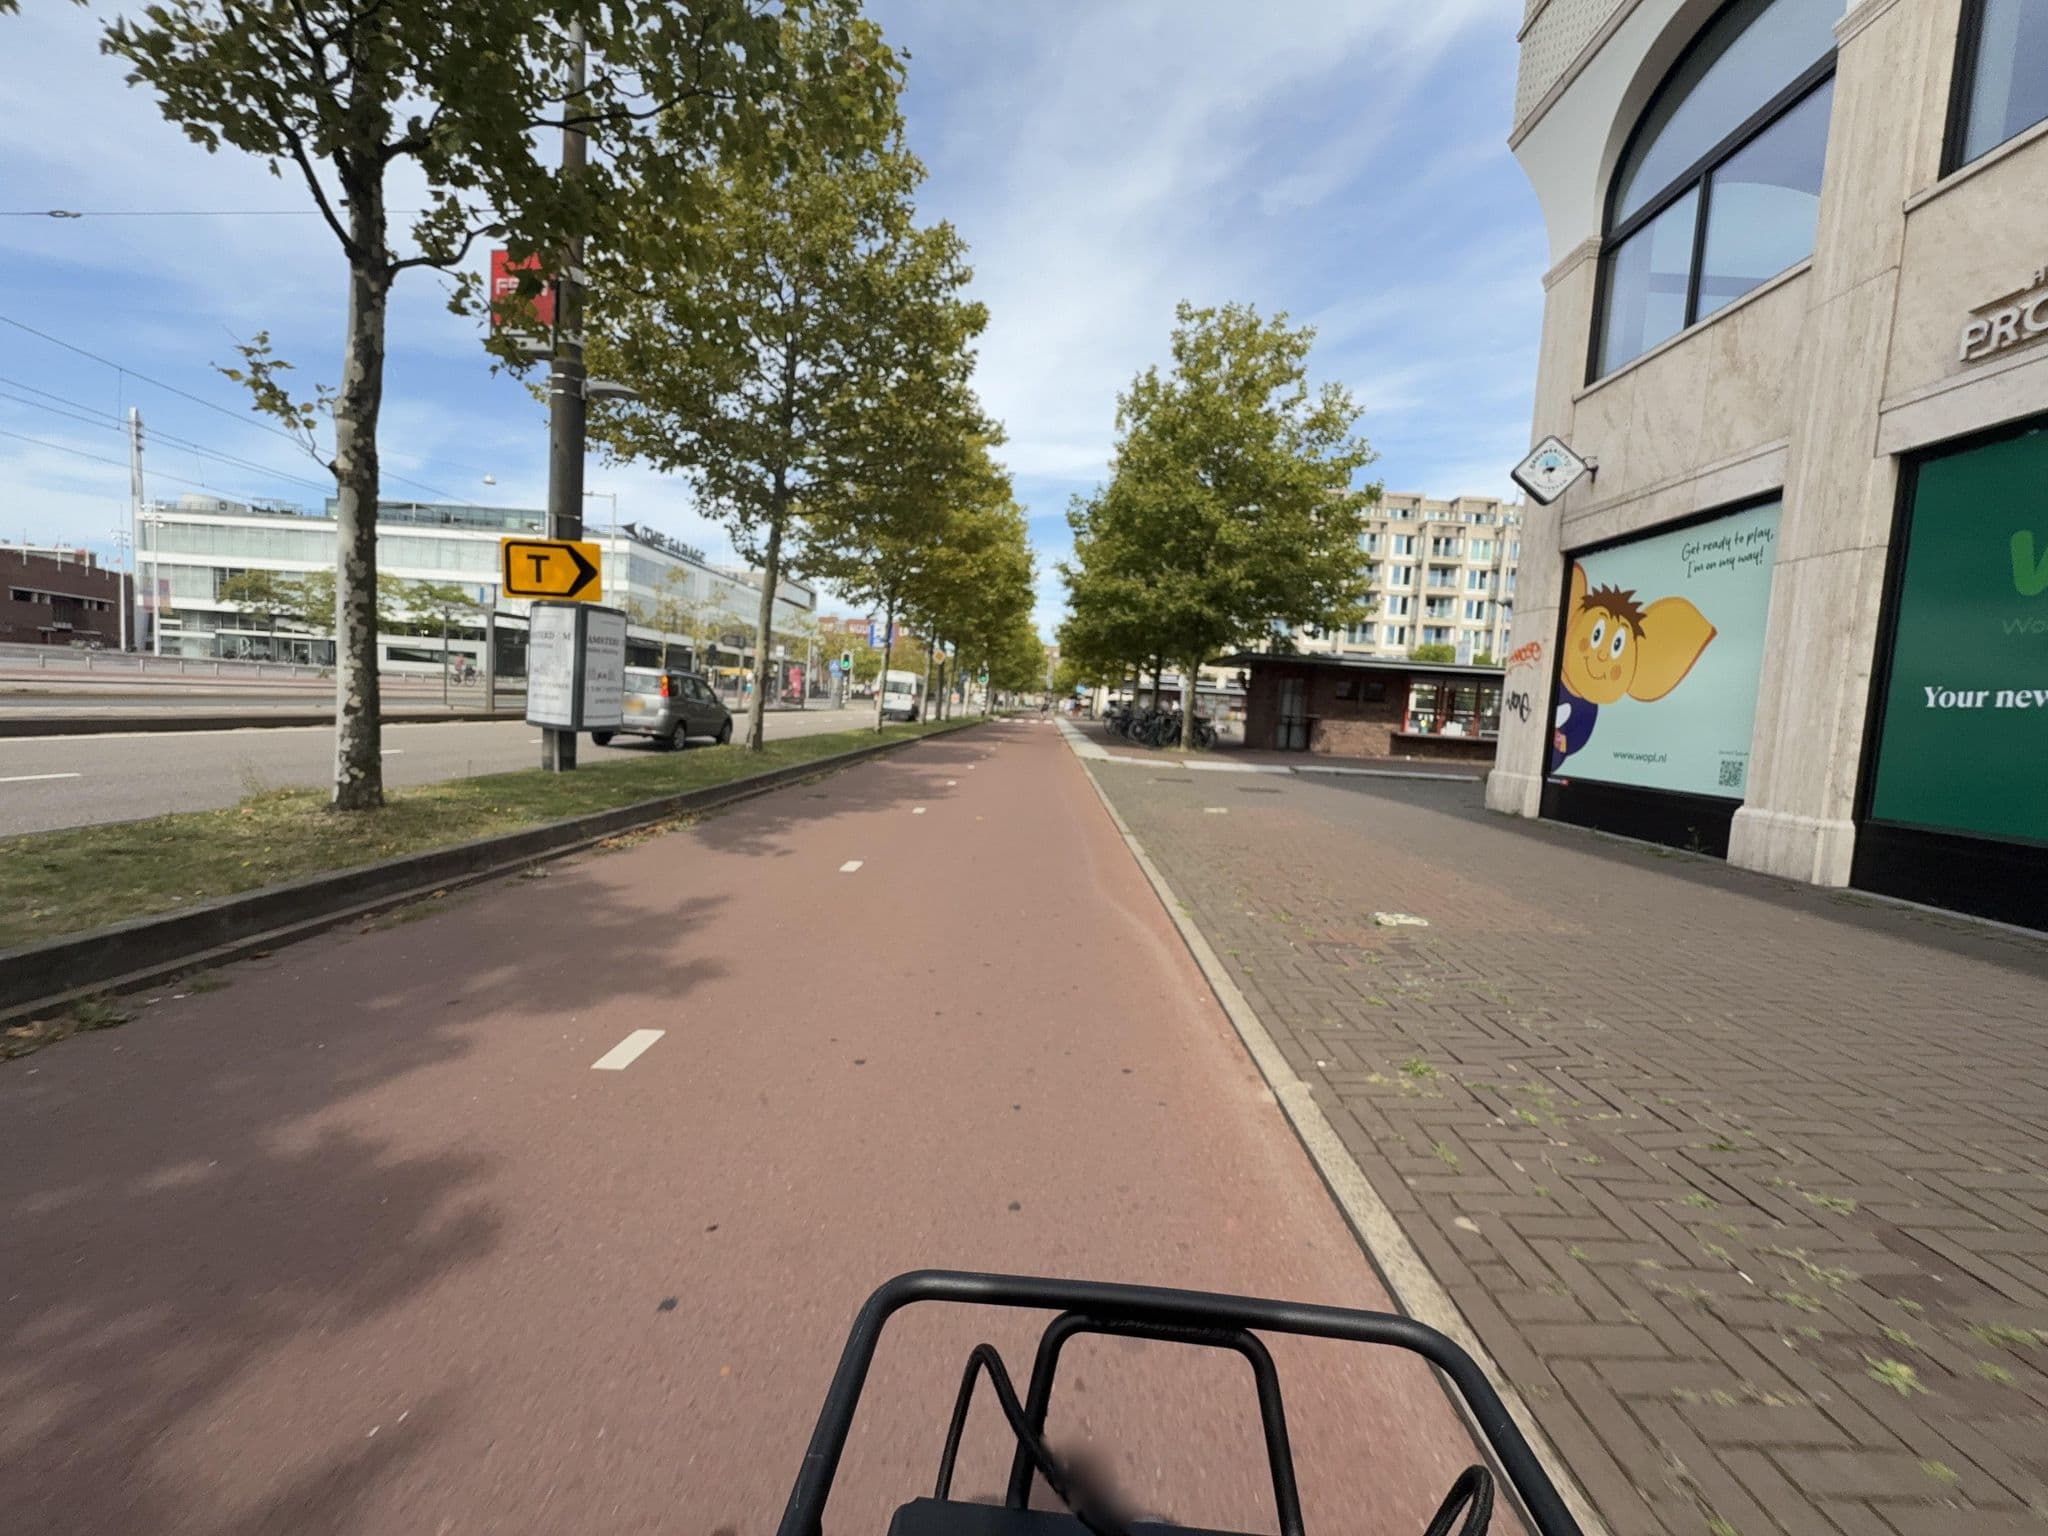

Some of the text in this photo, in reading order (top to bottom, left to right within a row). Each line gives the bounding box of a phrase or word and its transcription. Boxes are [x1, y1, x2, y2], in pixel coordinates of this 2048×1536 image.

[1681, 541, 1700, 562] Get
[1703, 536, 1731, 553] ready
[1734, 531, 1744, 545] to
[1706, 561, 1717, 571] on
[1719, 557, 1735, 571] my
[1738, 545, 1764, 567] way!
[527, 554, 551, 583] T
[1924, 686, 1990, 709] Your
[1613, 750, 1668, 765] www.wopl.nl
